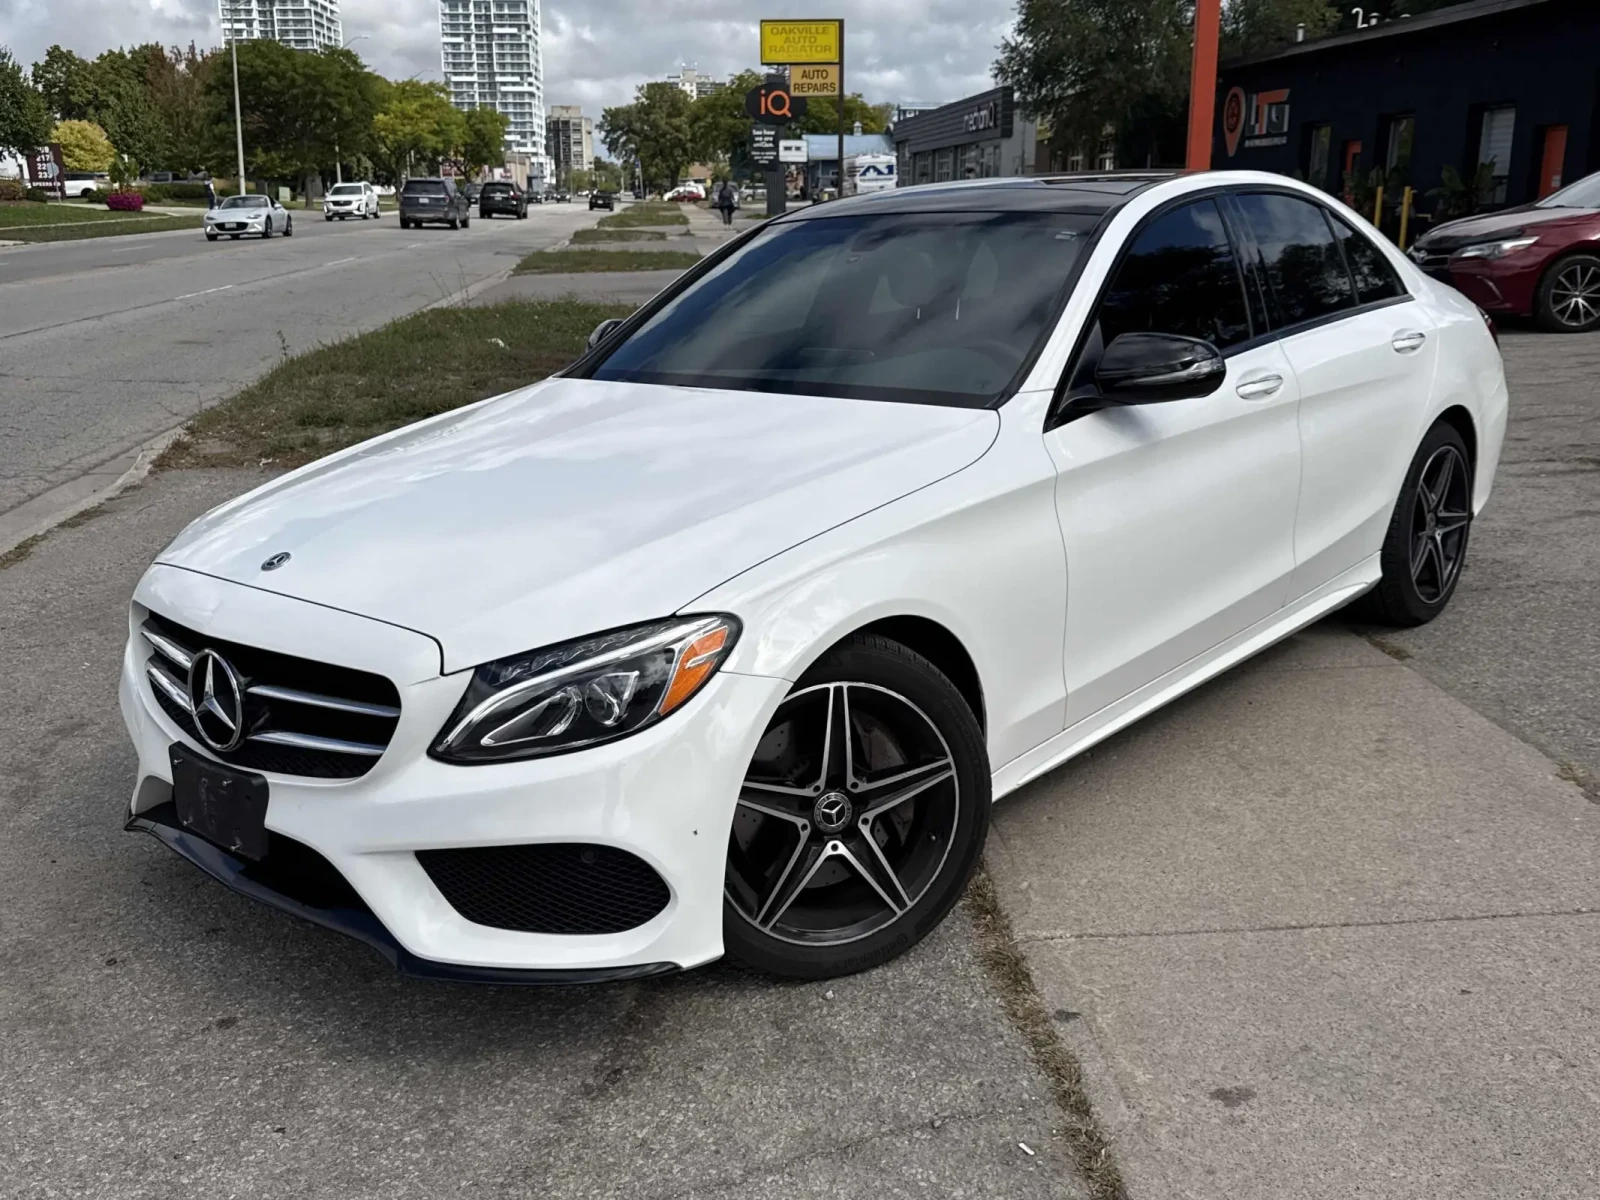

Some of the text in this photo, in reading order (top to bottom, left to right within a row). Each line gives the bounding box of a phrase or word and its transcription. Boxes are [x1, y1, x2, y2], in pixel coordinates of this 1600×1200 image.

[770, 26, 830, 35] OAKVILLE
[783, 36, 817, 44] AUTO
[769, 44, 832, 53] RADIATOR
[801, 69, 829, 80] AUTO
[793, 82, 837, 93] REPAIRS
[760, 89, 792, 117] iQ
